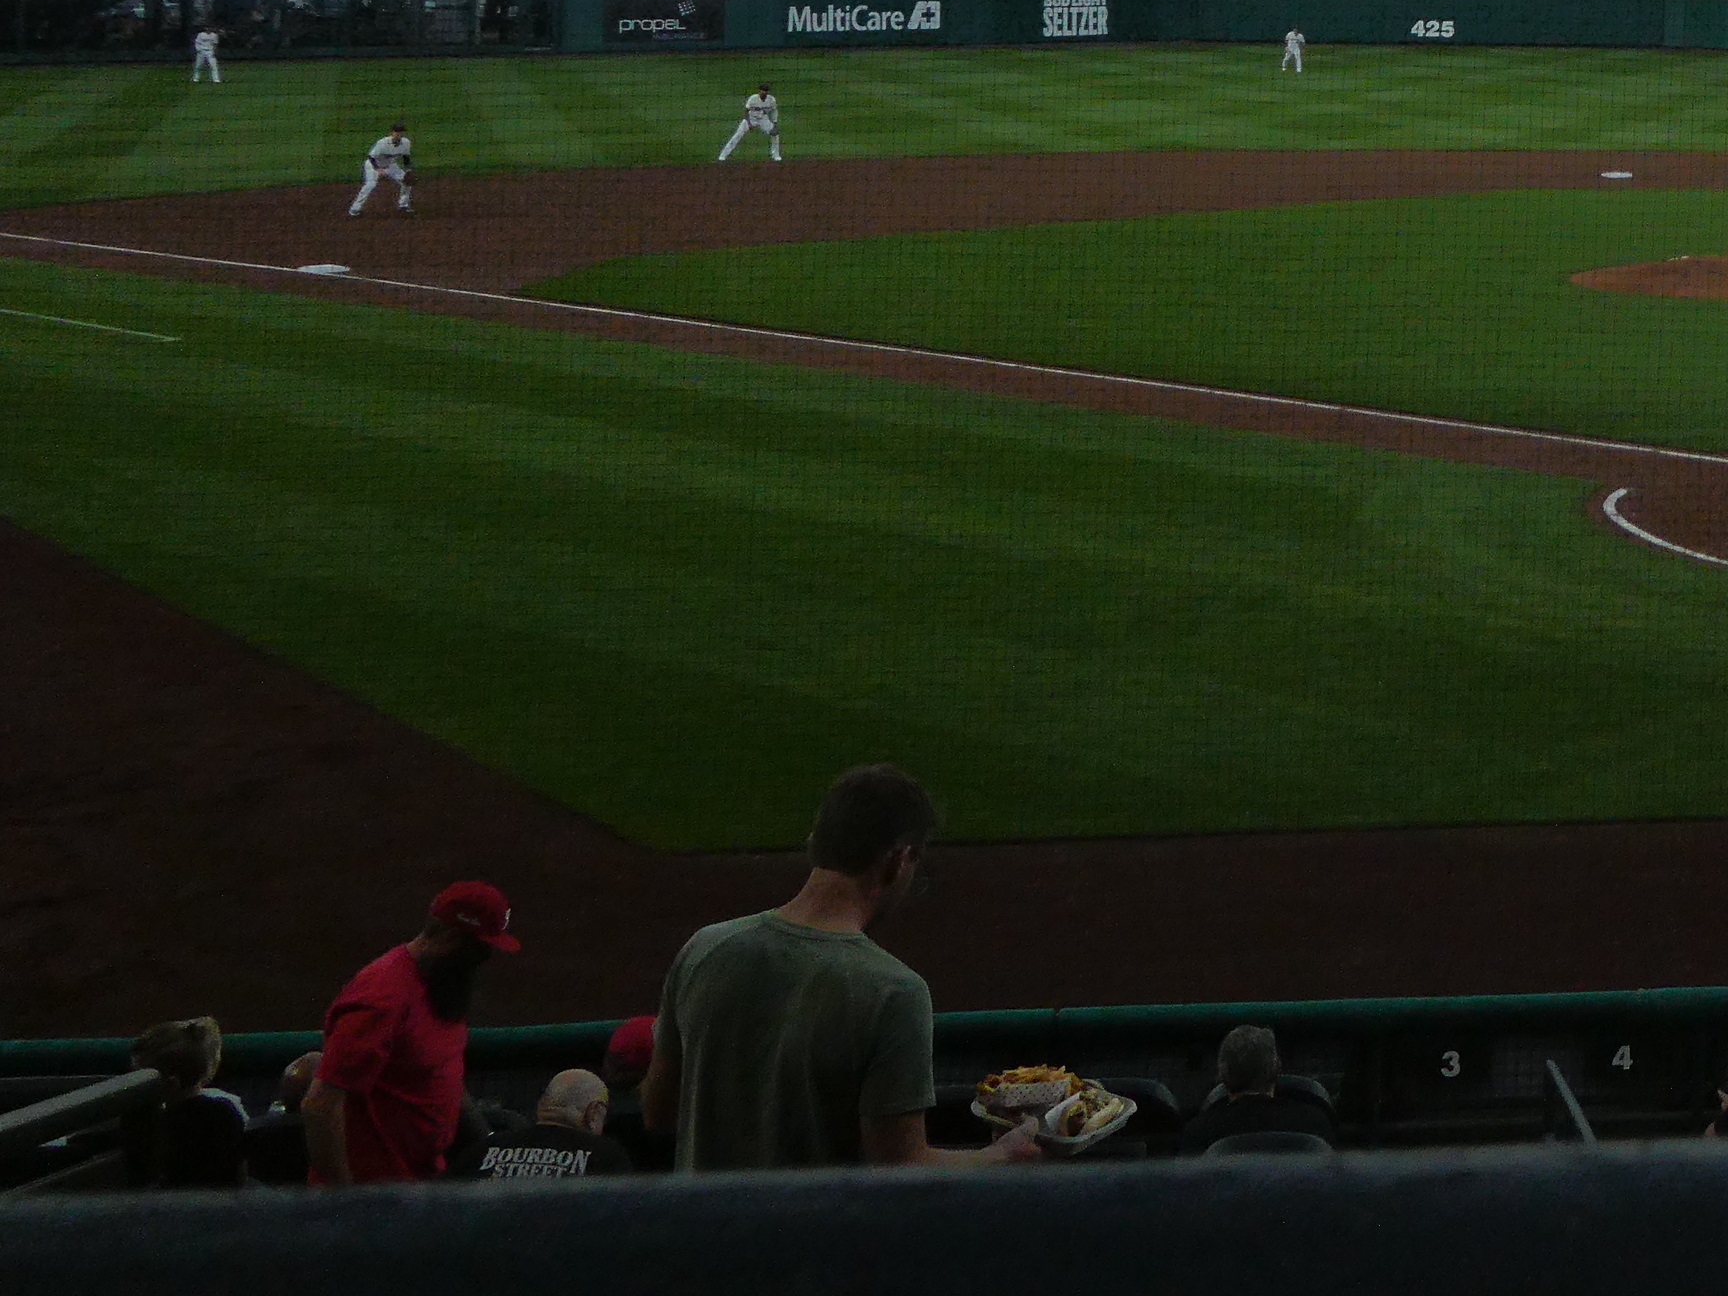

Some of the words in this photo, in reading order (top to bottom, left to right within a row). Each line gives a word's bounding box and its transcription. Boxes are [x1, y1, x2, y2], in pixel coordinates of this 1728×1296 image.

[787, 5, 906, 33] MultiCare
[1042, 7, 1108, 38] SELTZER
[1410, 20, 1455, 38] 425
[1440, 1050, 1461, 1078] 3
[1612, 1044, 1634, 1070] 4
[479, 1146, 592, 1175] BOURBON
[494, 1164, 568, 1179] STREET
